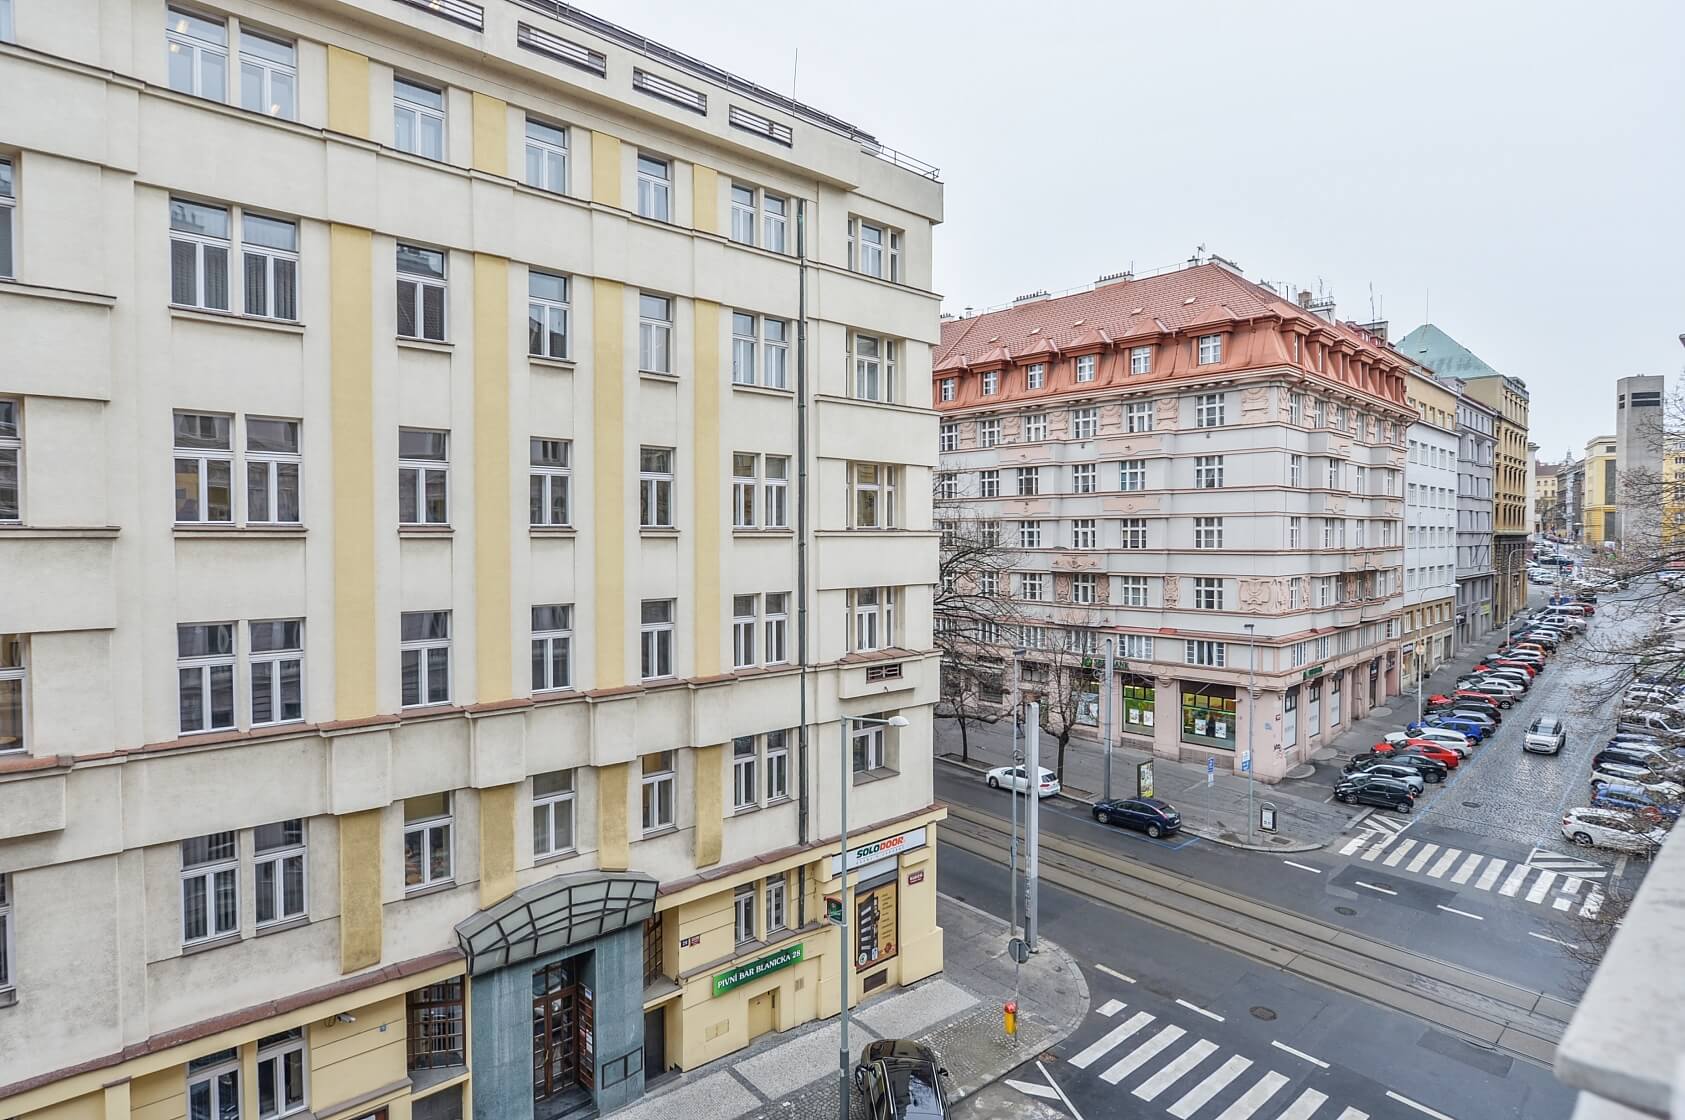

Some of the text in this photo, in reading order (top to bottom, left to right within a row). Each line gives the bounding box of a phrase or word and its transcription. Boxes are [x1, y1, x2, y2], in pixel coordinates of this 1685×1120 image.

[856, 836, 904, 859] SOLODOOR
[717, 972, 738, 989] PIVNÍ
[739, 968, 755, 981] BAR
[791, 949, 801, 959] 28
